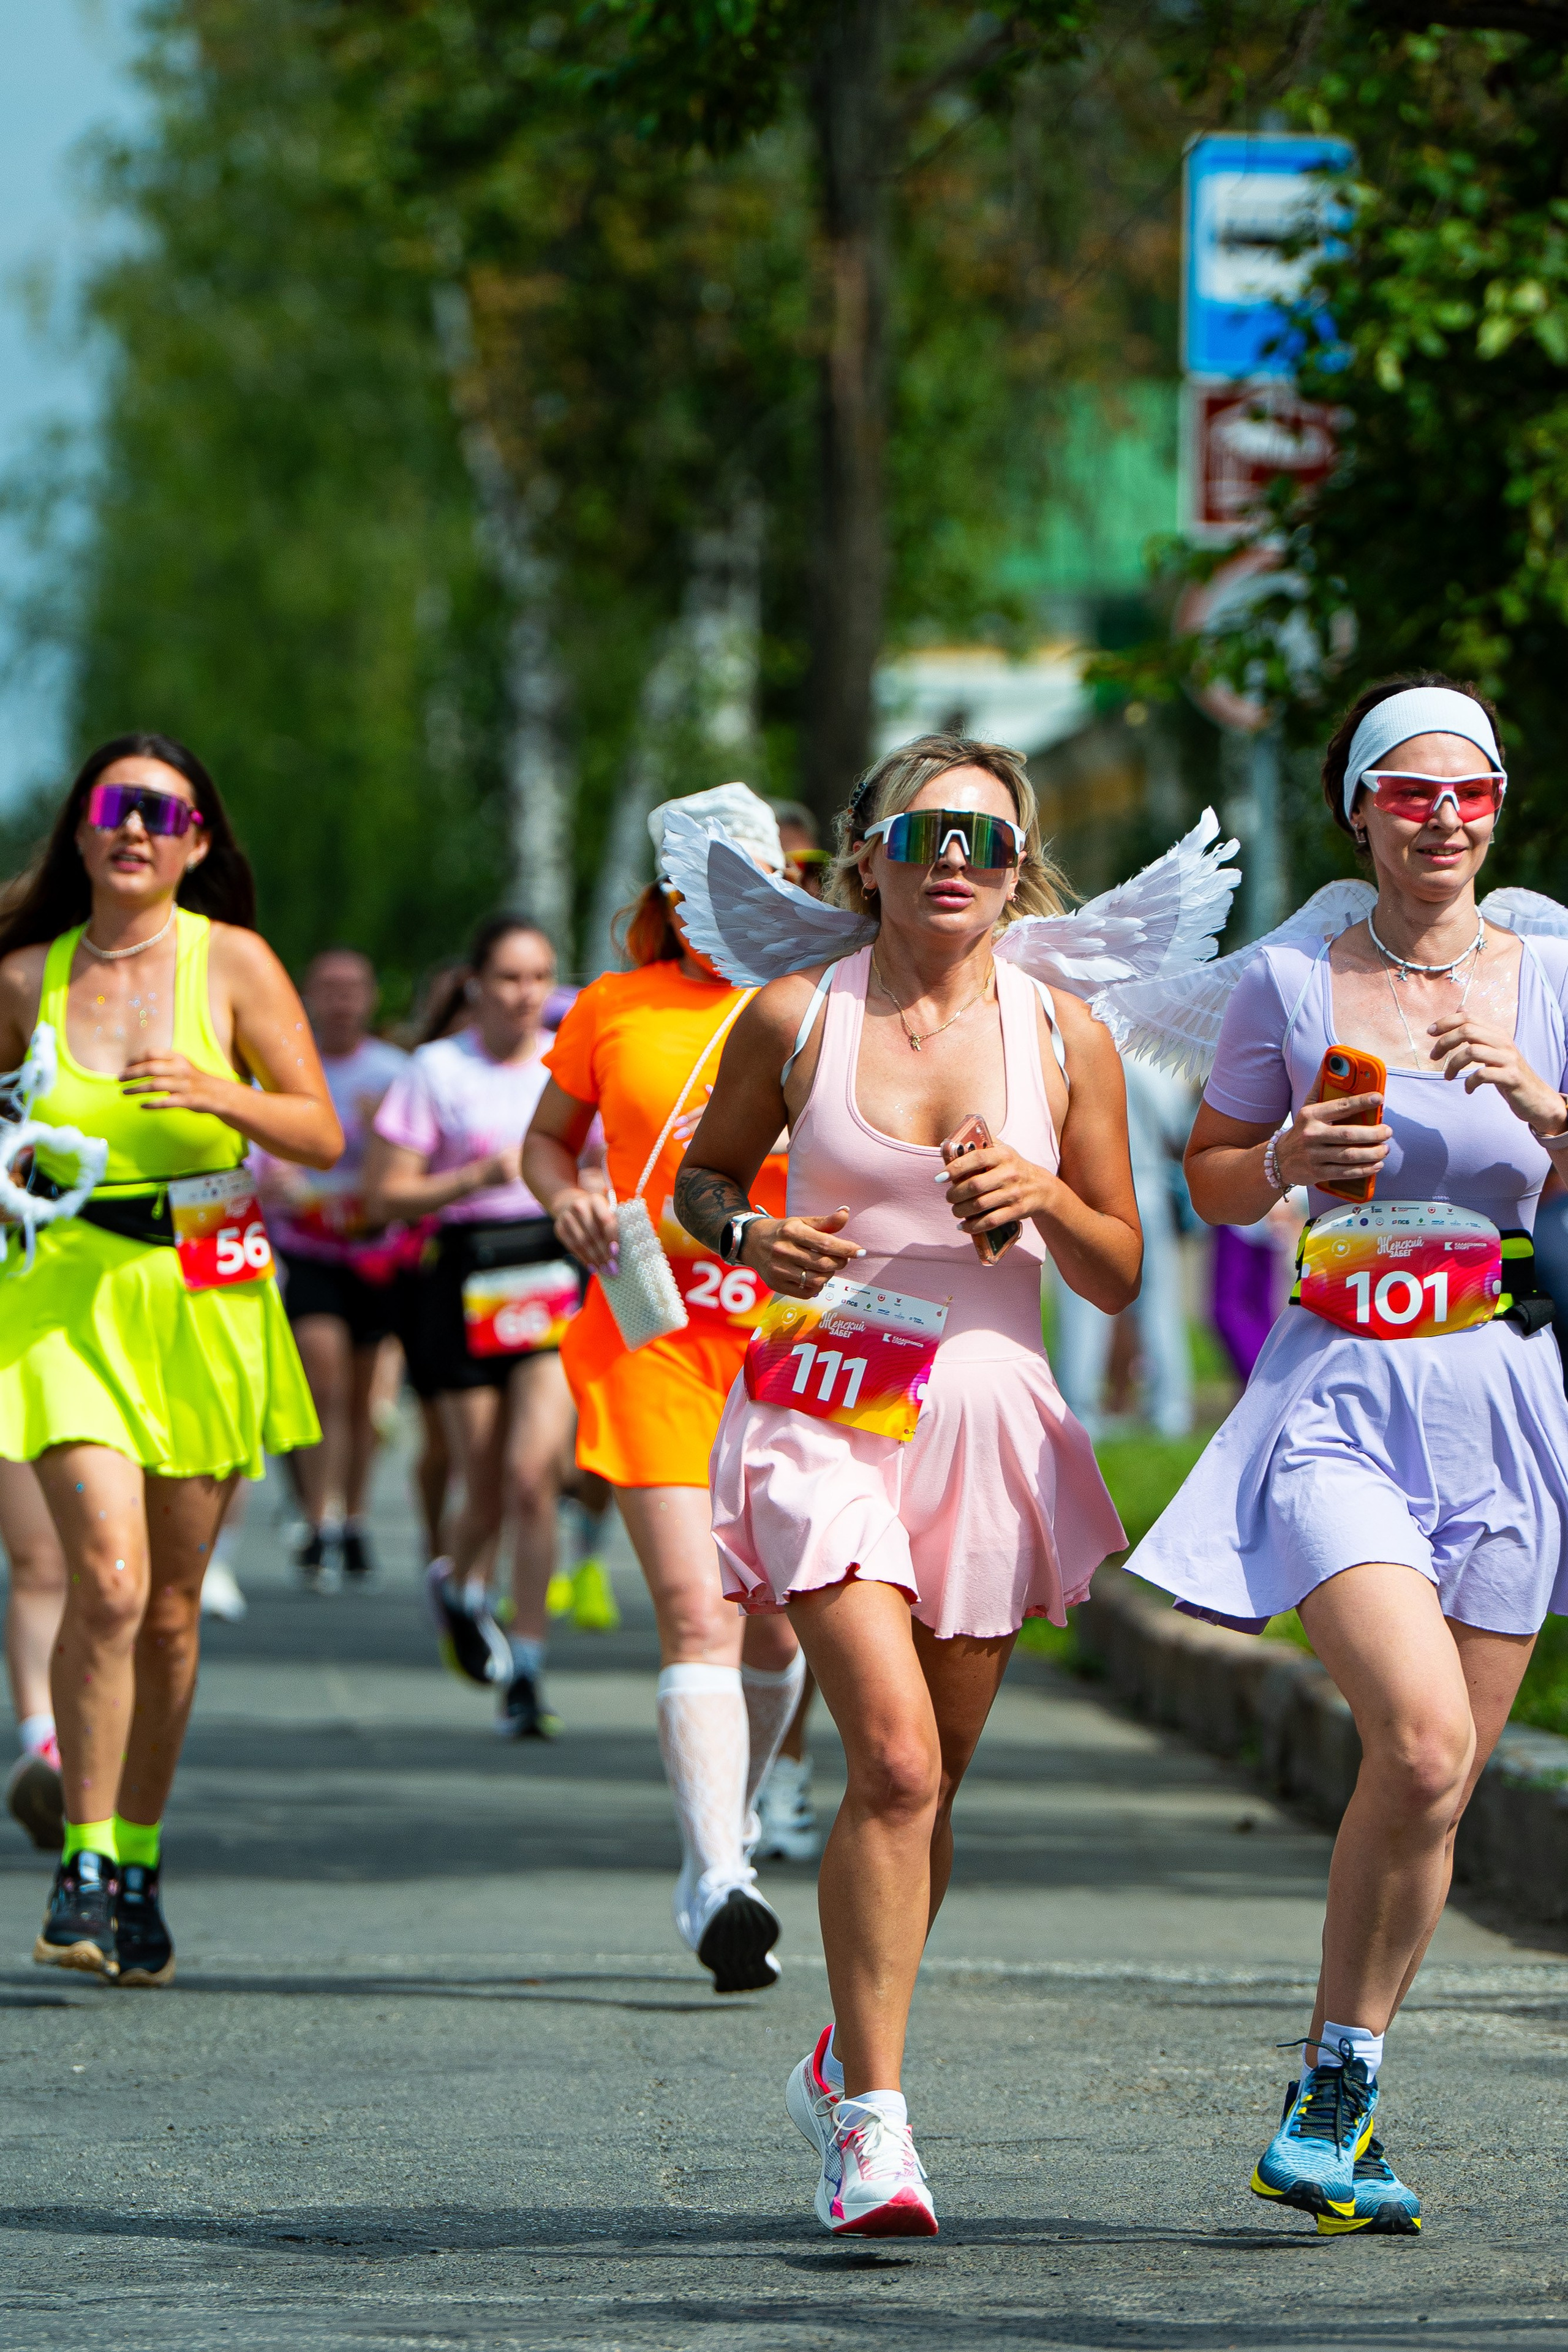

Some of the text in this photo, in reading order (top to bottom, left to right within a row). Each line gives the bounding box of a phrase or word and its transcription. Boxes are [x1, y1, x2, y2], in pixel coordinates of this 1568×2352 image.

[216, 1221, 271, 1275] 56
[1377, 1234, 1425, 1254] Женский
[1389, 1249, 1413, 1258] ЗАБЕГ
[685, 1261, 758, 1314] 26
[1346, 1270, 1449, 1325] 101
[818, 1311, 867, 1332] Женский
[829, 1327, 854, 1338] ЗАБЕГ
[790, 1342, 869, 1409] 111
